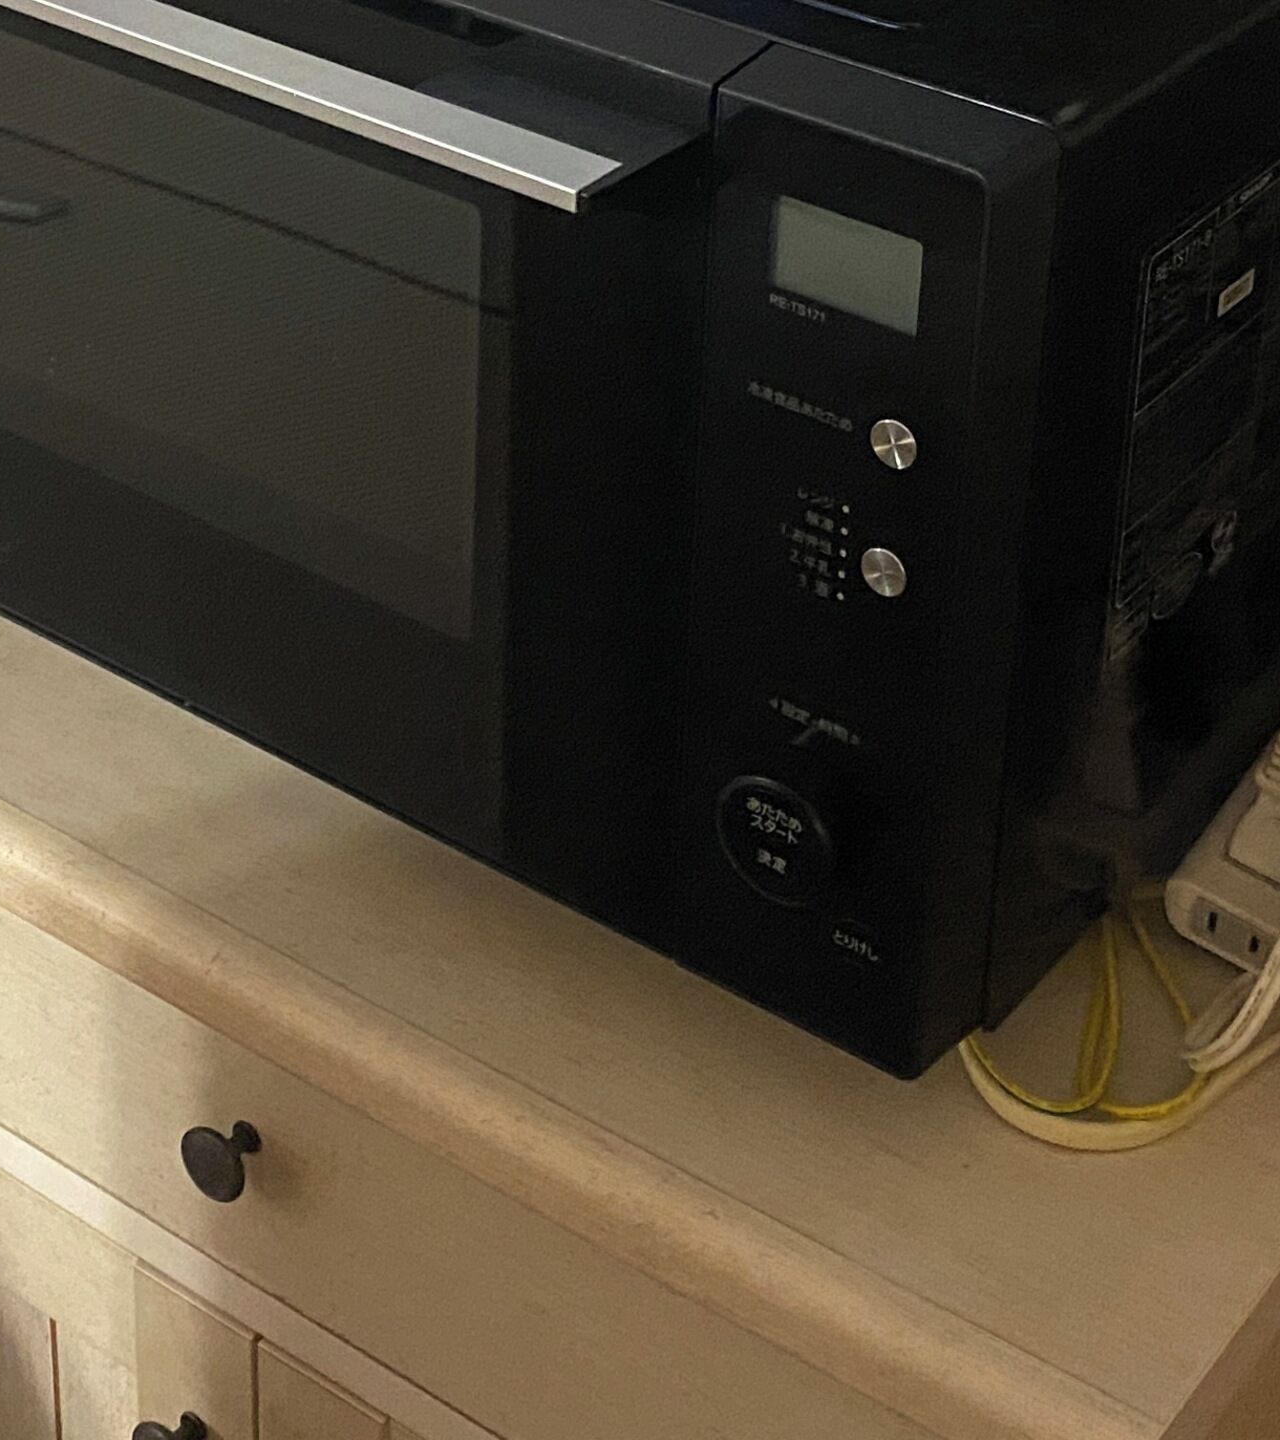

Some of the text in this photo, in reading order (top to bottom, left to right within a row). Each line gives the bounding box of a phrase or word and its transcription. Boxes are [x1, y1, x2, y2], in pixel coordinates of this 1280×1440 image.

[746, 796, 803, 834] あたため
[750, 813, 799, 845] スタート
[832, 929, 879, 962] とりけし
